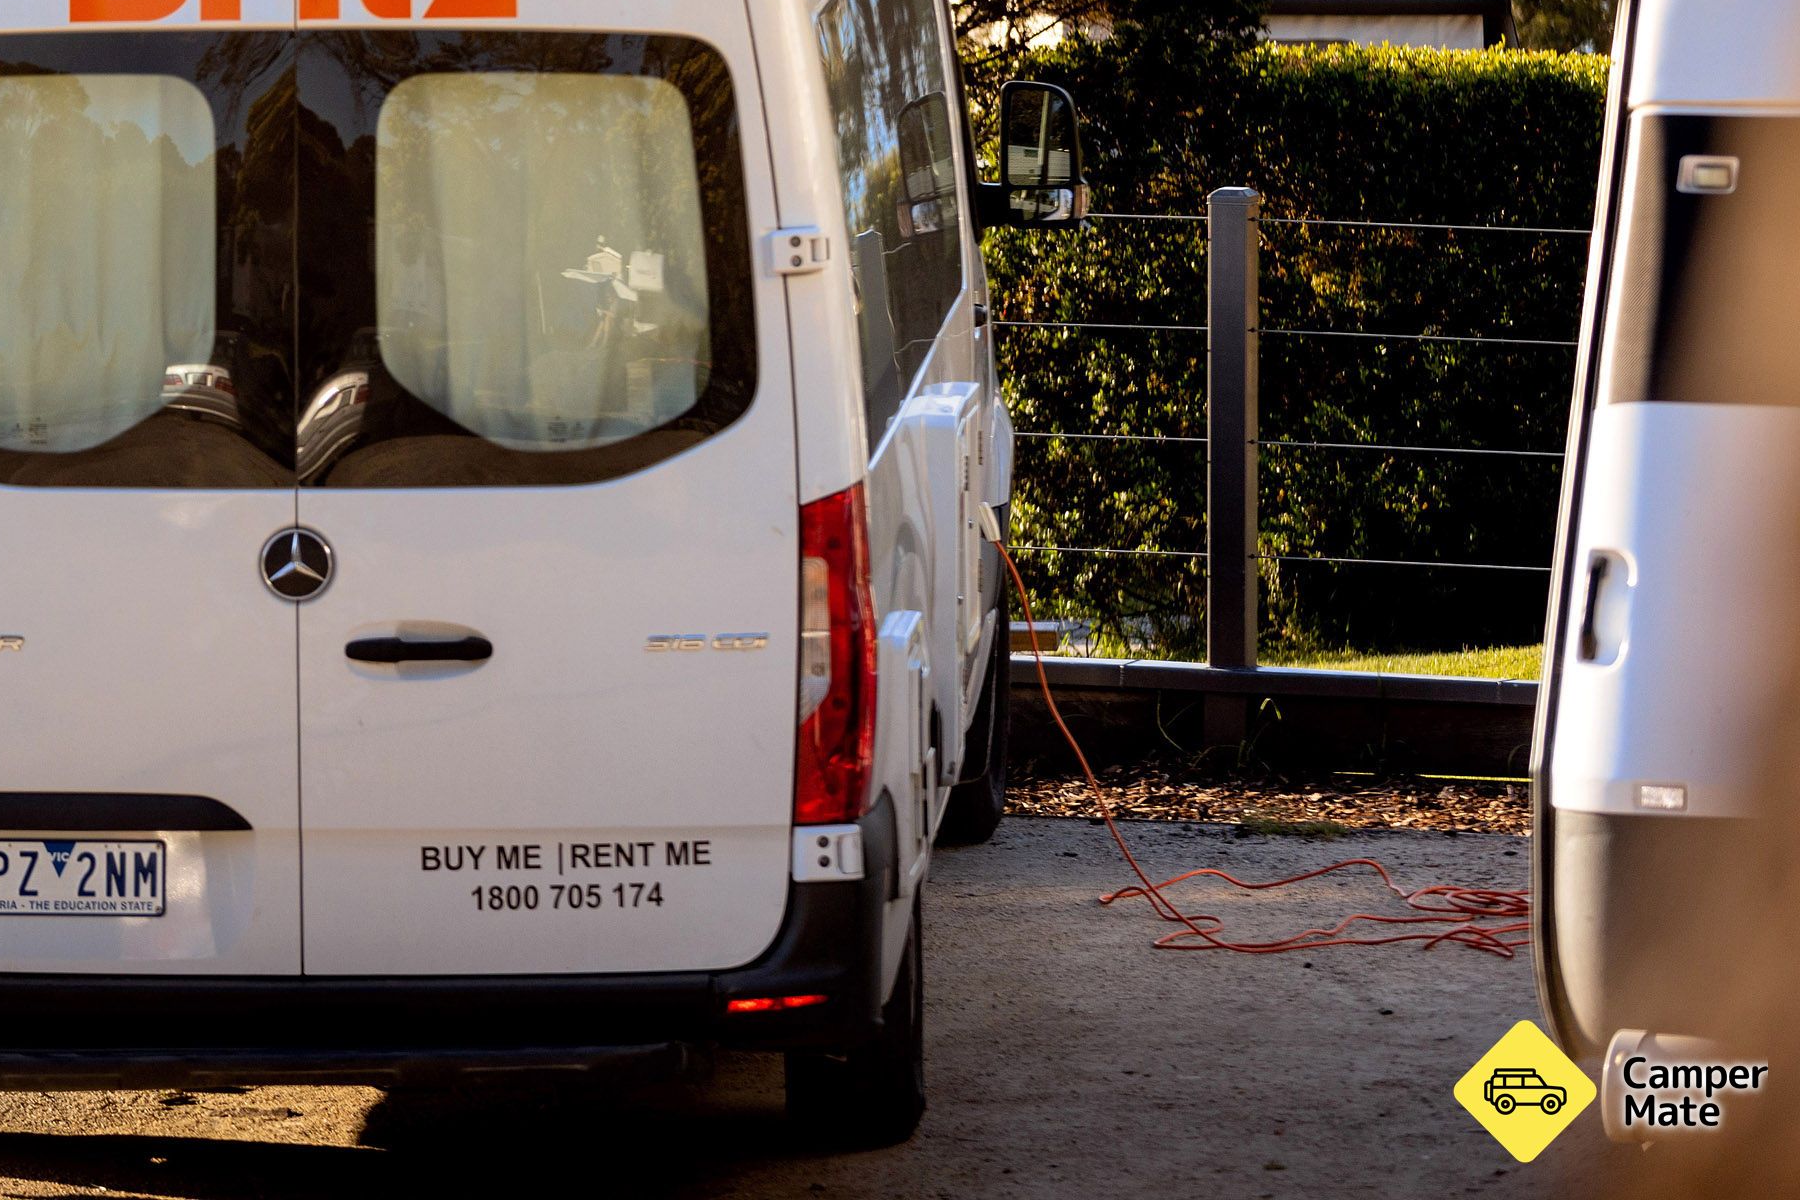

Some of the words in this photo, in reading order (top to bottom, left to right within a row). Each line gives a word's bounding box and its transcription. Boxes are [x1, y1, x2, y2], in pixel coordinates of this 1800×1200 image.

[421, 845, 486, 871] BUY
[496, 845, 542, 870] ME
[665, 841, 711, 866] ME
[77, 851, 157, 897] 2NM
[30, 901, 50, 910] THE
[54, 901, 117, 911] EDUCATION
[120, 902, 153, 911] STATE
[471, 885, 539, 910] 1800
[550, 884, 602, 909] 705
[612, 882, 664, 908] 174
